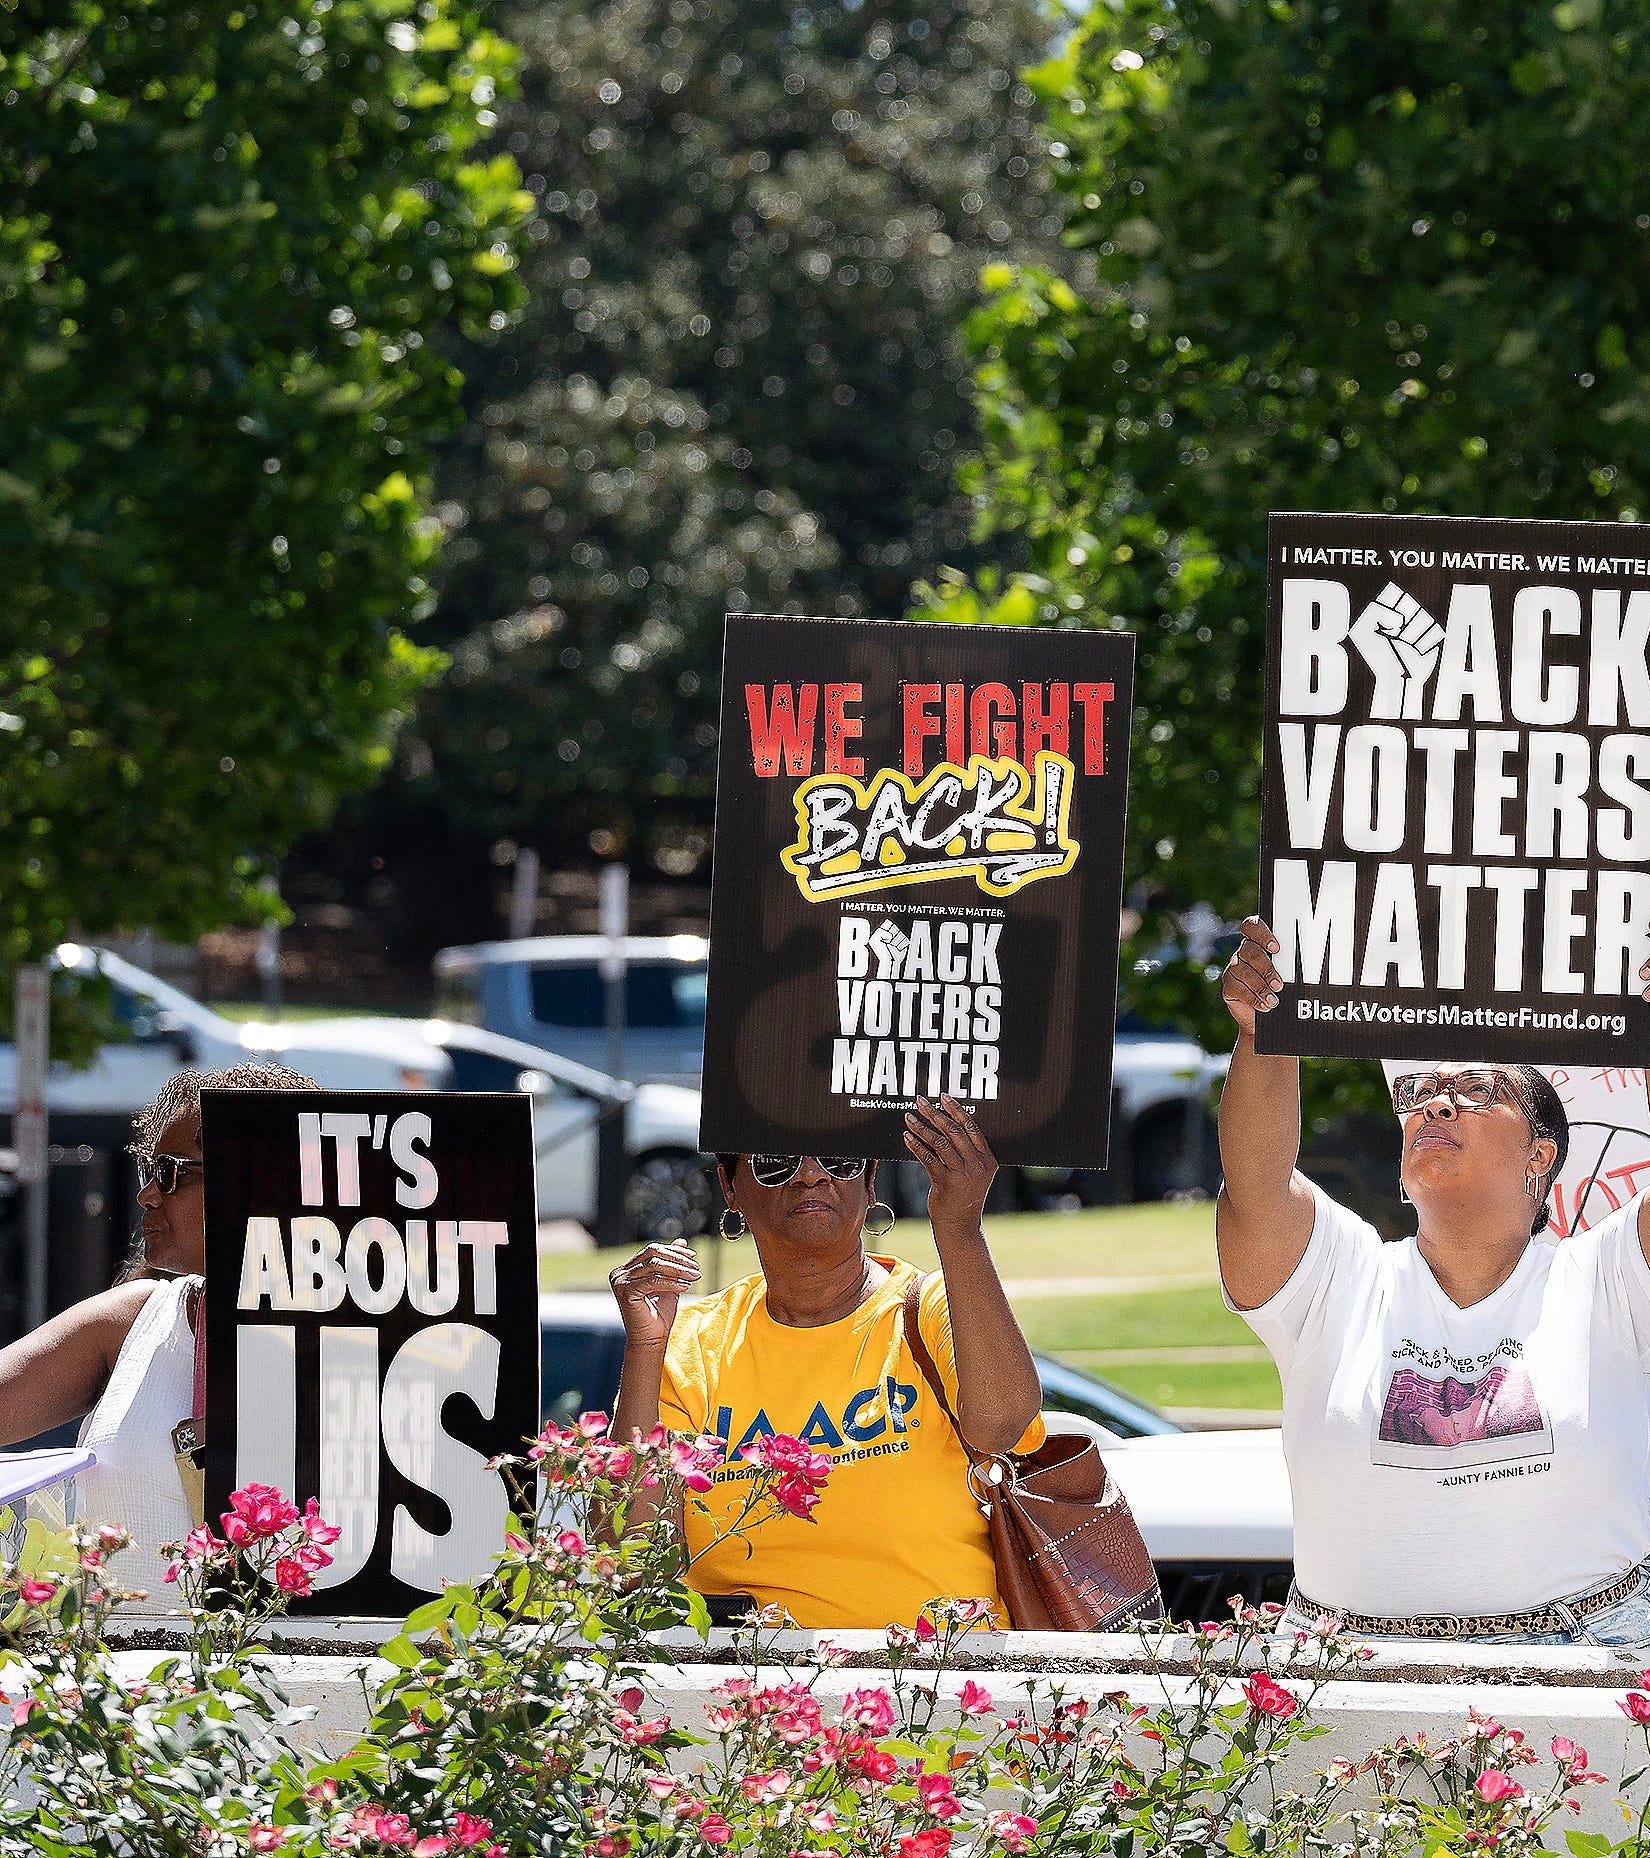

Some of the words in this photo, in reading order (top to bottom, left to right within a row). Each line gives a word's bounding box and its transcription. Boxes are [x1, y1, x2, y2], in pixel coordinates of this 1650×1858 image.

[1282, 547, 1287, 564] I
[1294, 548, 1382, 566] MATTER.
[1389, 550, 1435, 568] YOU
[1442, 552, 1530, 571] MATTER.
[1537, 556, 1571, 573] WE
[744, 681, 864, 777] WE
[902, 681, 1115, 777] FIGHT
[796, 760, 1064, 866] BACK!
[841, 902, 844, 911] I
[886, 903, 907, 913] YOU
[949, 906, 964, 916] WE
[966, 908, 1006, 918] MATTER.
[836, 979, 1002, 1042] VOTERS
[1297, 1001, 1627, 1036] BlackVotersMatterFund.org
[830, 1038, 1001, 1101] MATTER
[299, 1111, 439, 1210] IT'S
[237, 1217, 510, 1316] ABOUT
[1391, 1348, 1415, 1359] SICK
[1418, 1358, 1441, 1369] AND
[236, 1322, 510, 1594] US
[831, 1440, 910, 1466] onference
[1484, 1466, 1524, 1481] FANNIE
[1528, 1462, 1551, 1475] LOU
